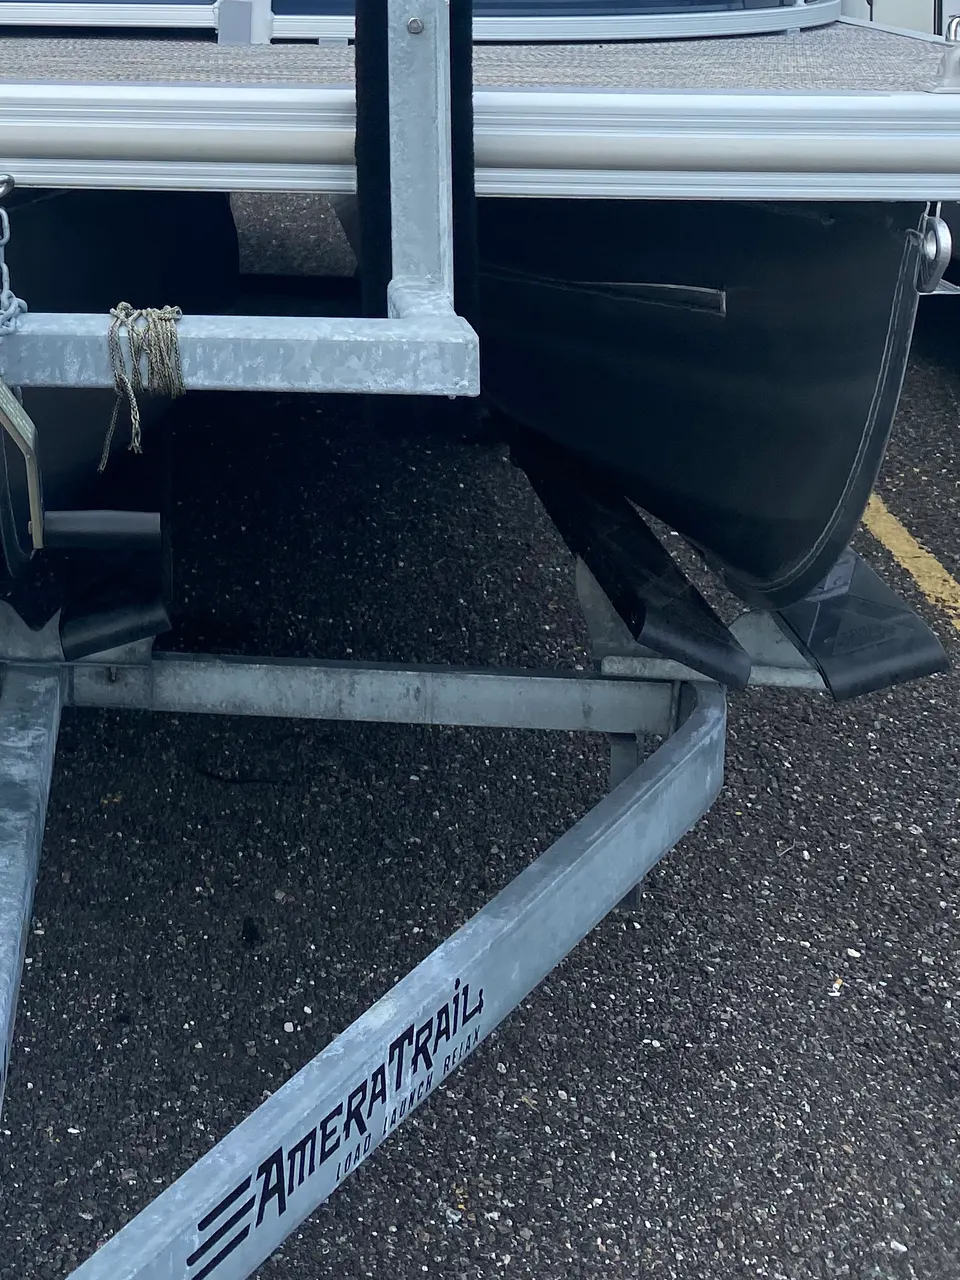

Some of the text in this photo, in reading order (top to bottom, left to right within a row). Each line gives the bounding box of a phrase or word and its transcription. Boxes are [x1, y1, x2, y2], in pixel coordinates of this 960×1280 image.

[335, 1024, 481, 1183] LOAD LAUNCH RELAX
